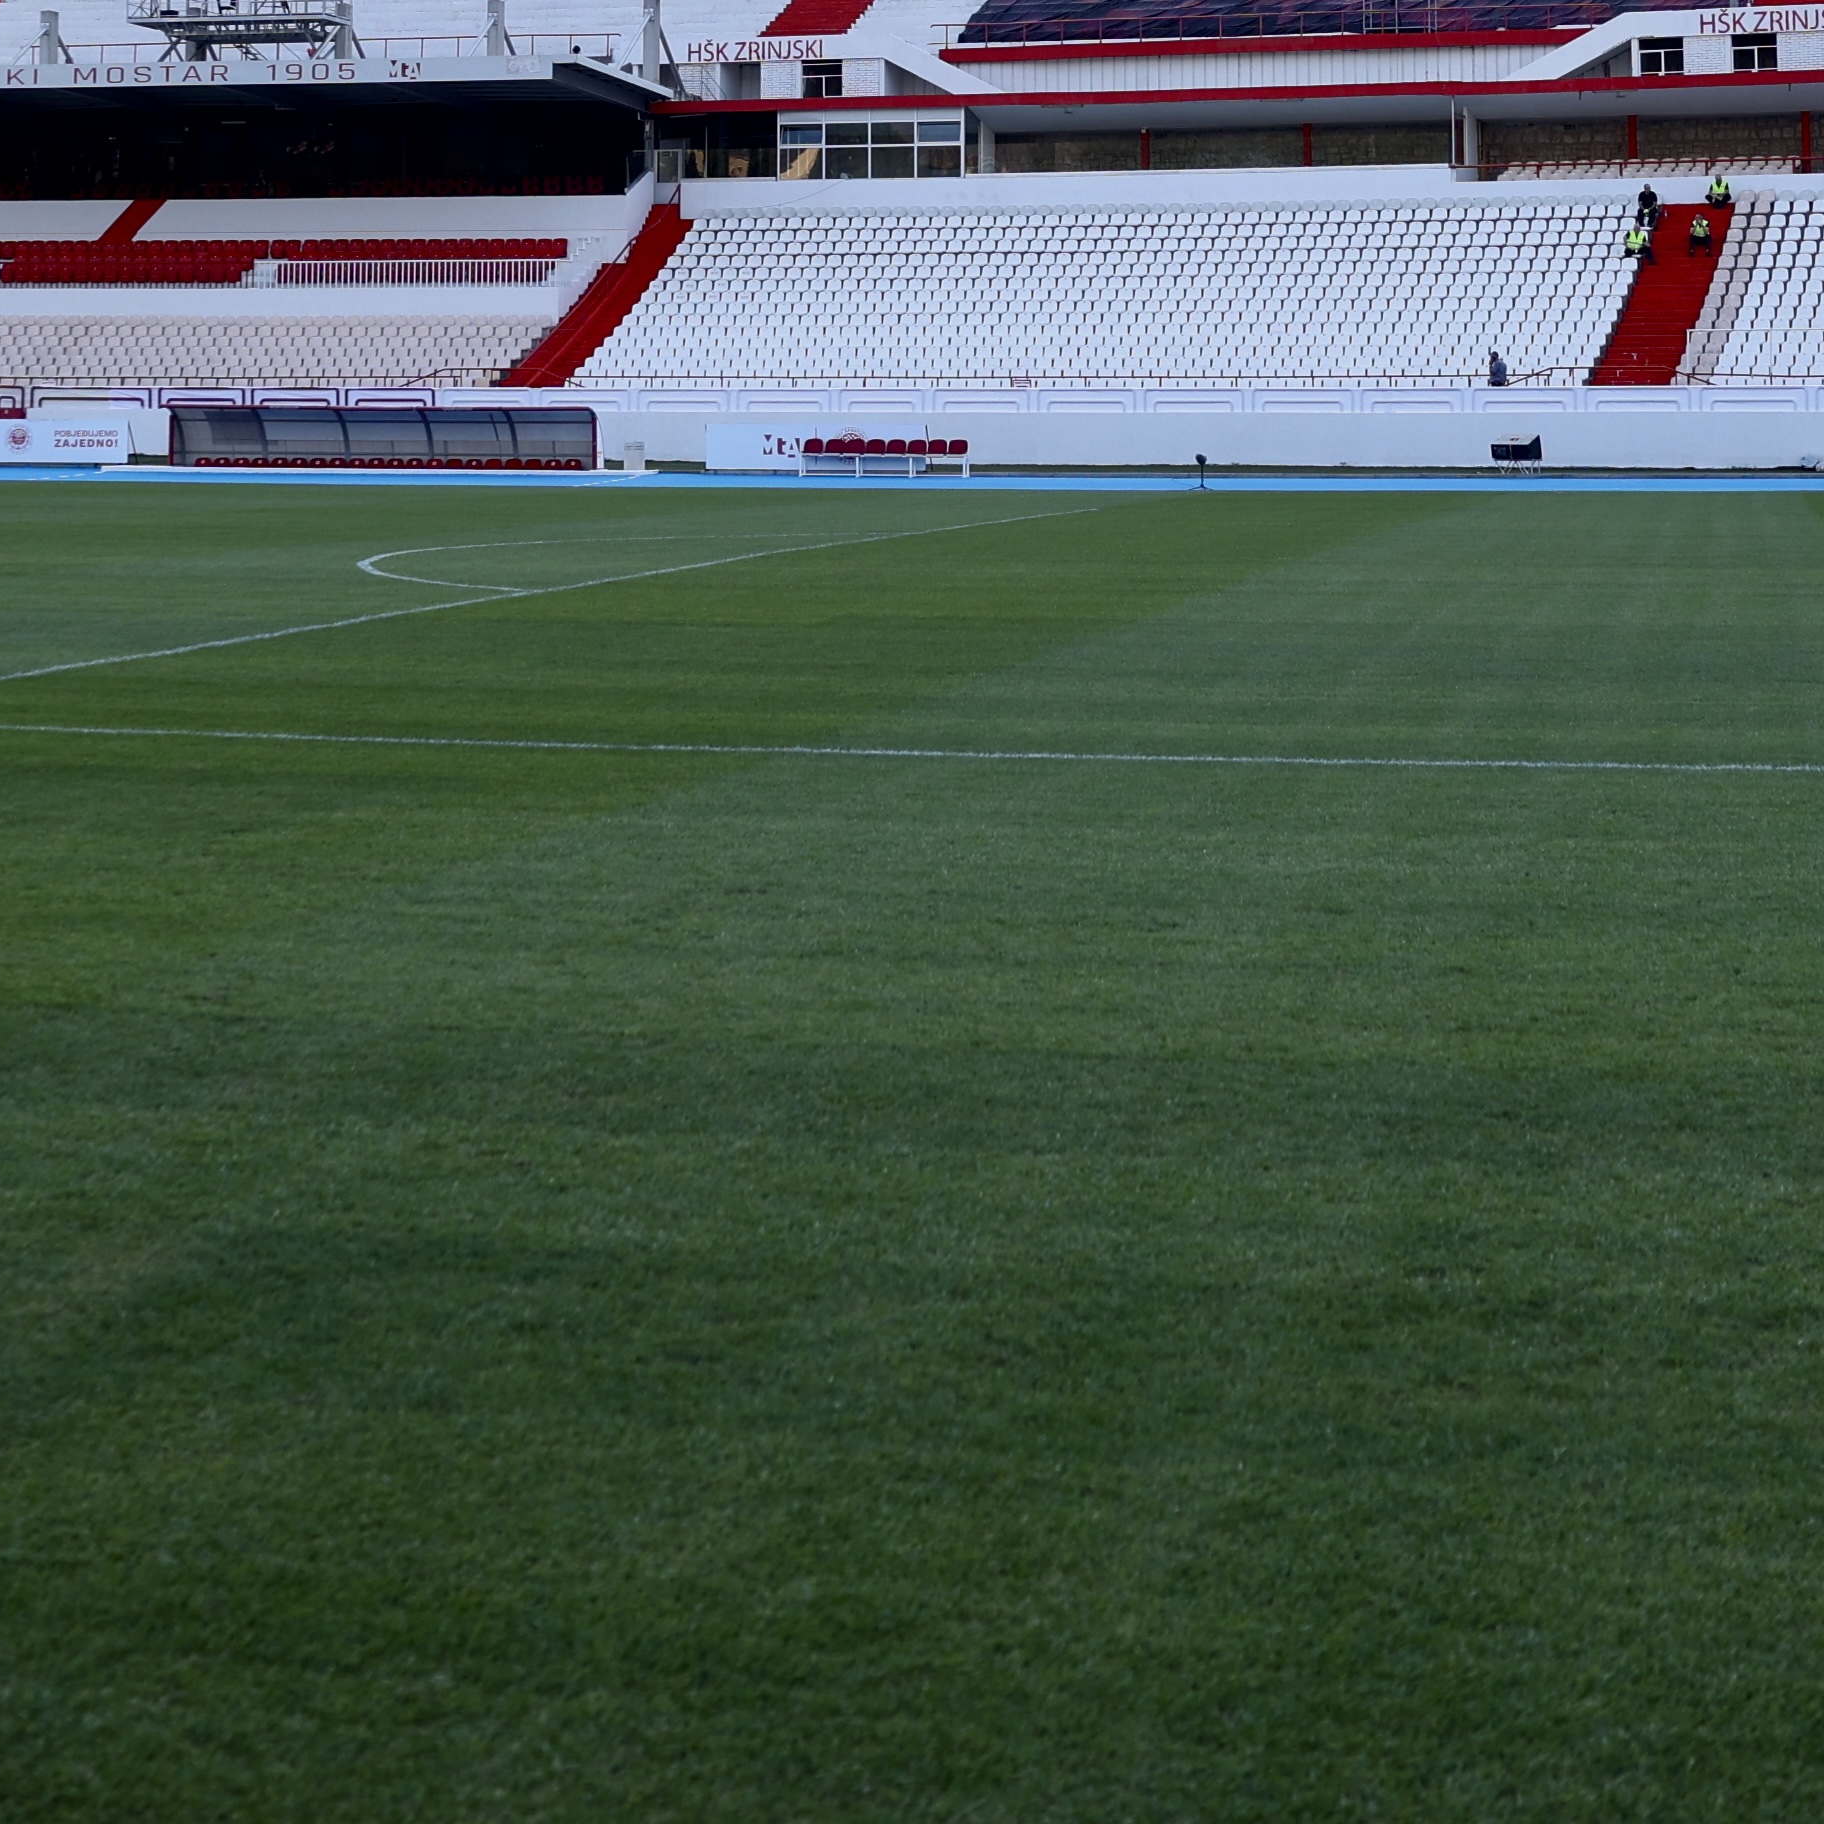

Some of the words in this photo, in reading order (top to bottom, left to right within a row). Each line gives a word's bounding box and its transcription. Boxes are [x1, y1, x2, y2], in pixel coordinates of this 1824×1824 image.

[1699, 9, 1747, 34] HŠK
[687, 39, 729, 62] HŠK
[734, 39, 823, 60] ZRINJSKI
[74, 65, 229, 84] MOSTAR
[267, 63, 356, 81] 1905
[54, 438, 118, 448] ZAJEDNO!
